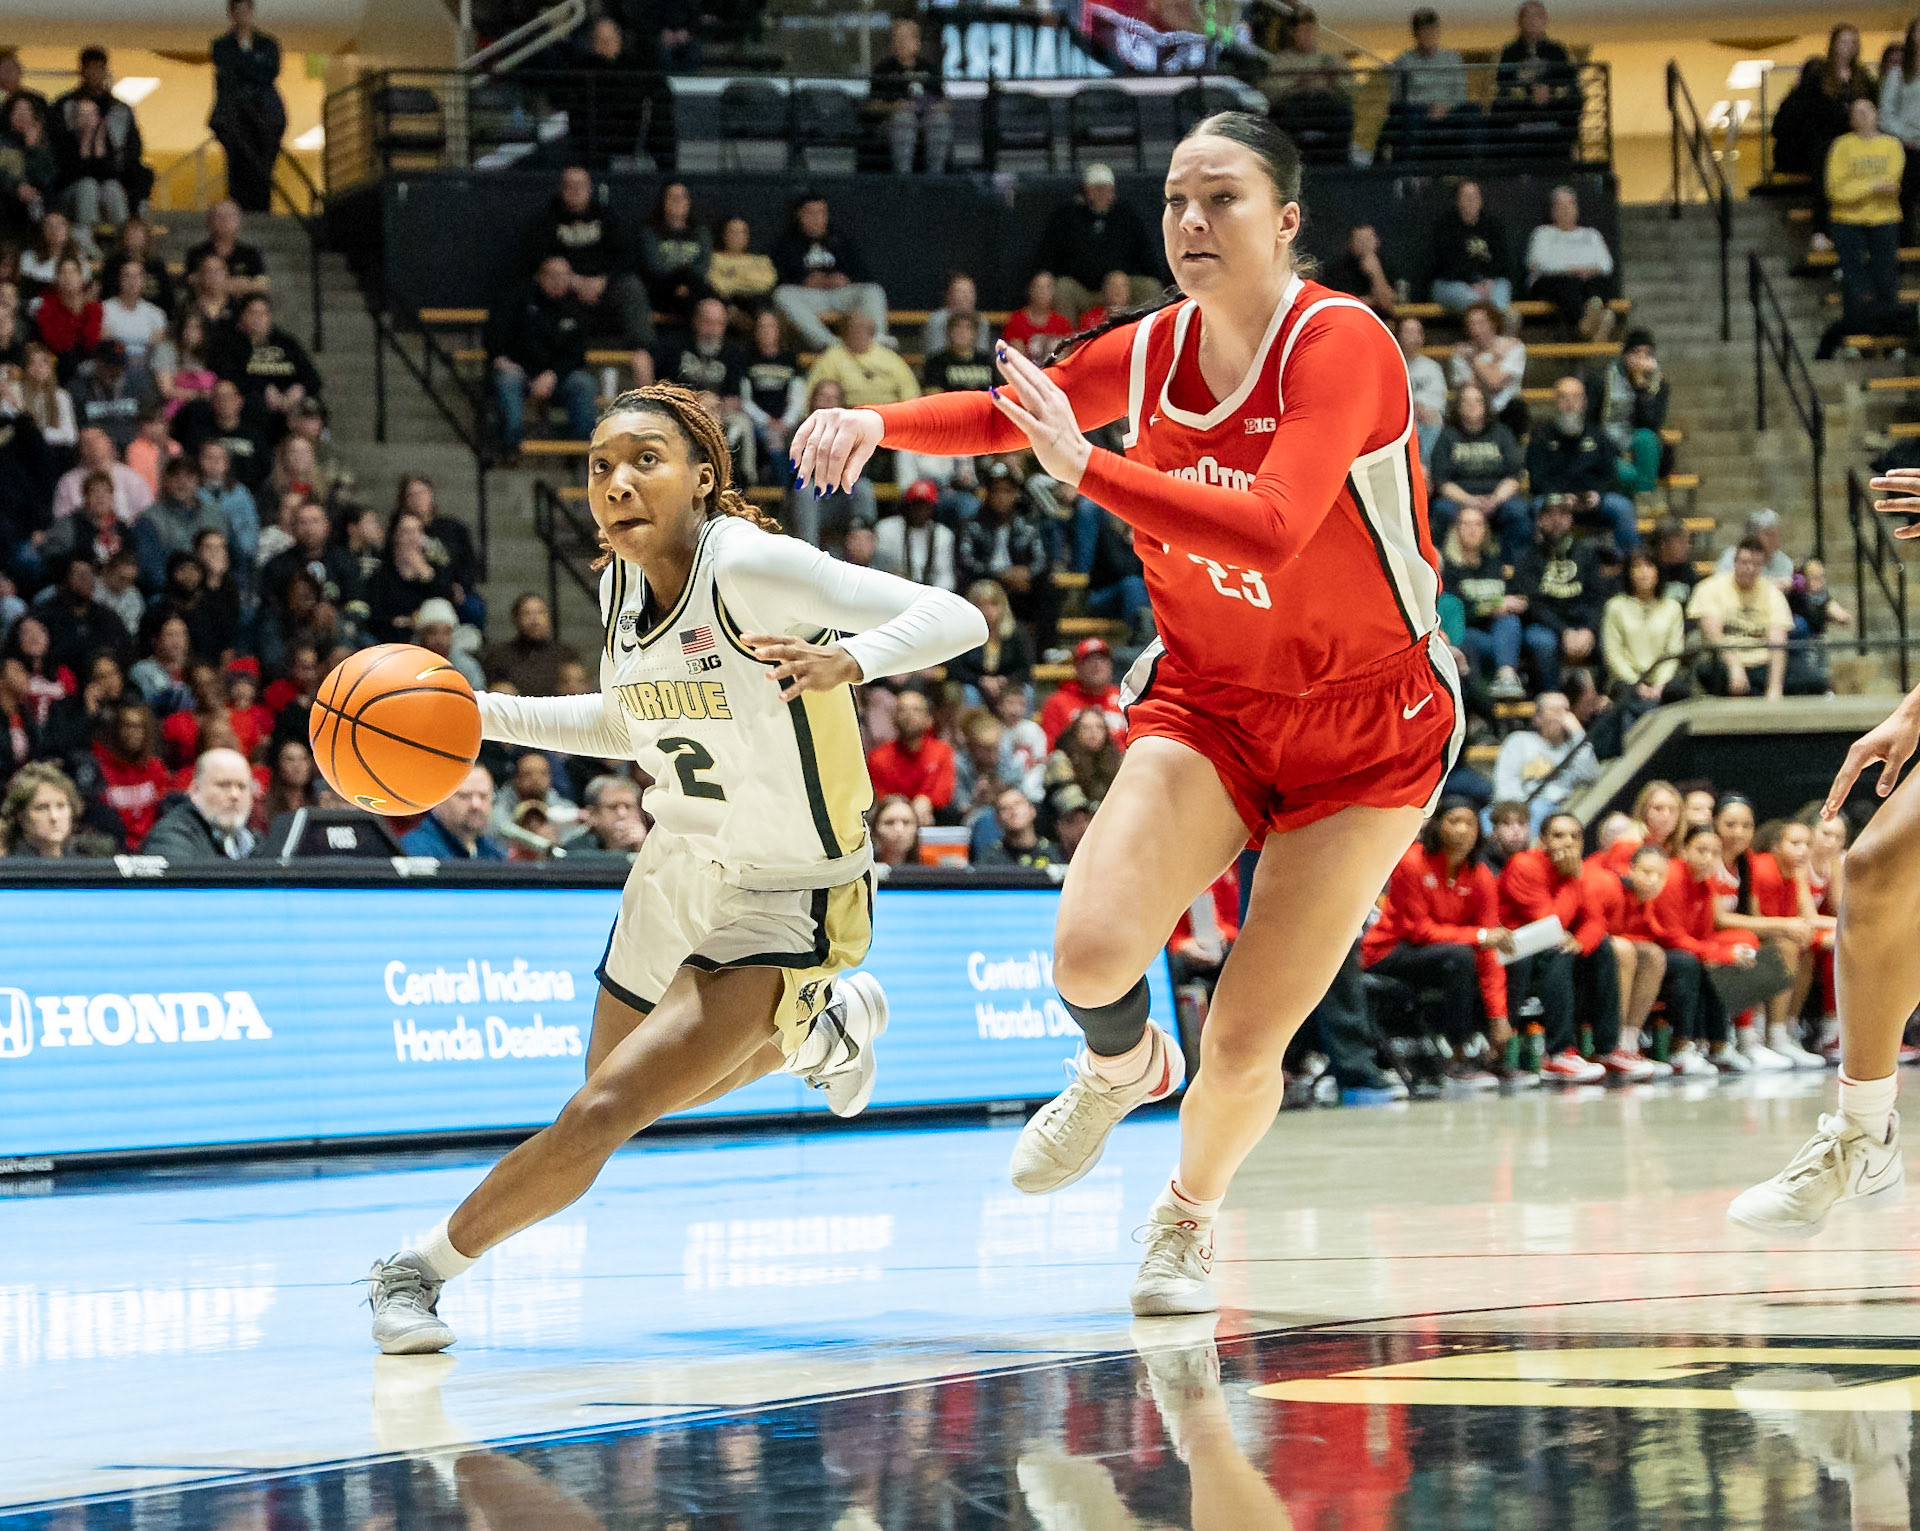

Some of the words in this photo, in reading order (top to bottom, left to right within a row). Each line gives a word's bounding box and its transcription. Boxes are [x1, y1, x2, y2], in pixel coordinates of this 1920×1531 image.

[656, 736, 727, 802] 2
[384, 957, 481, 1006] Central
[481, 956, 575, 1002] Indiana
[967, 950, 1041, 991] Central
[34, 991, 273, 1047] HONDA
[393, 1014, 485, 1062] Honda
[485, 1012, 583, 1059] Dealers
[975, 998, 1046, 1040] Honda
